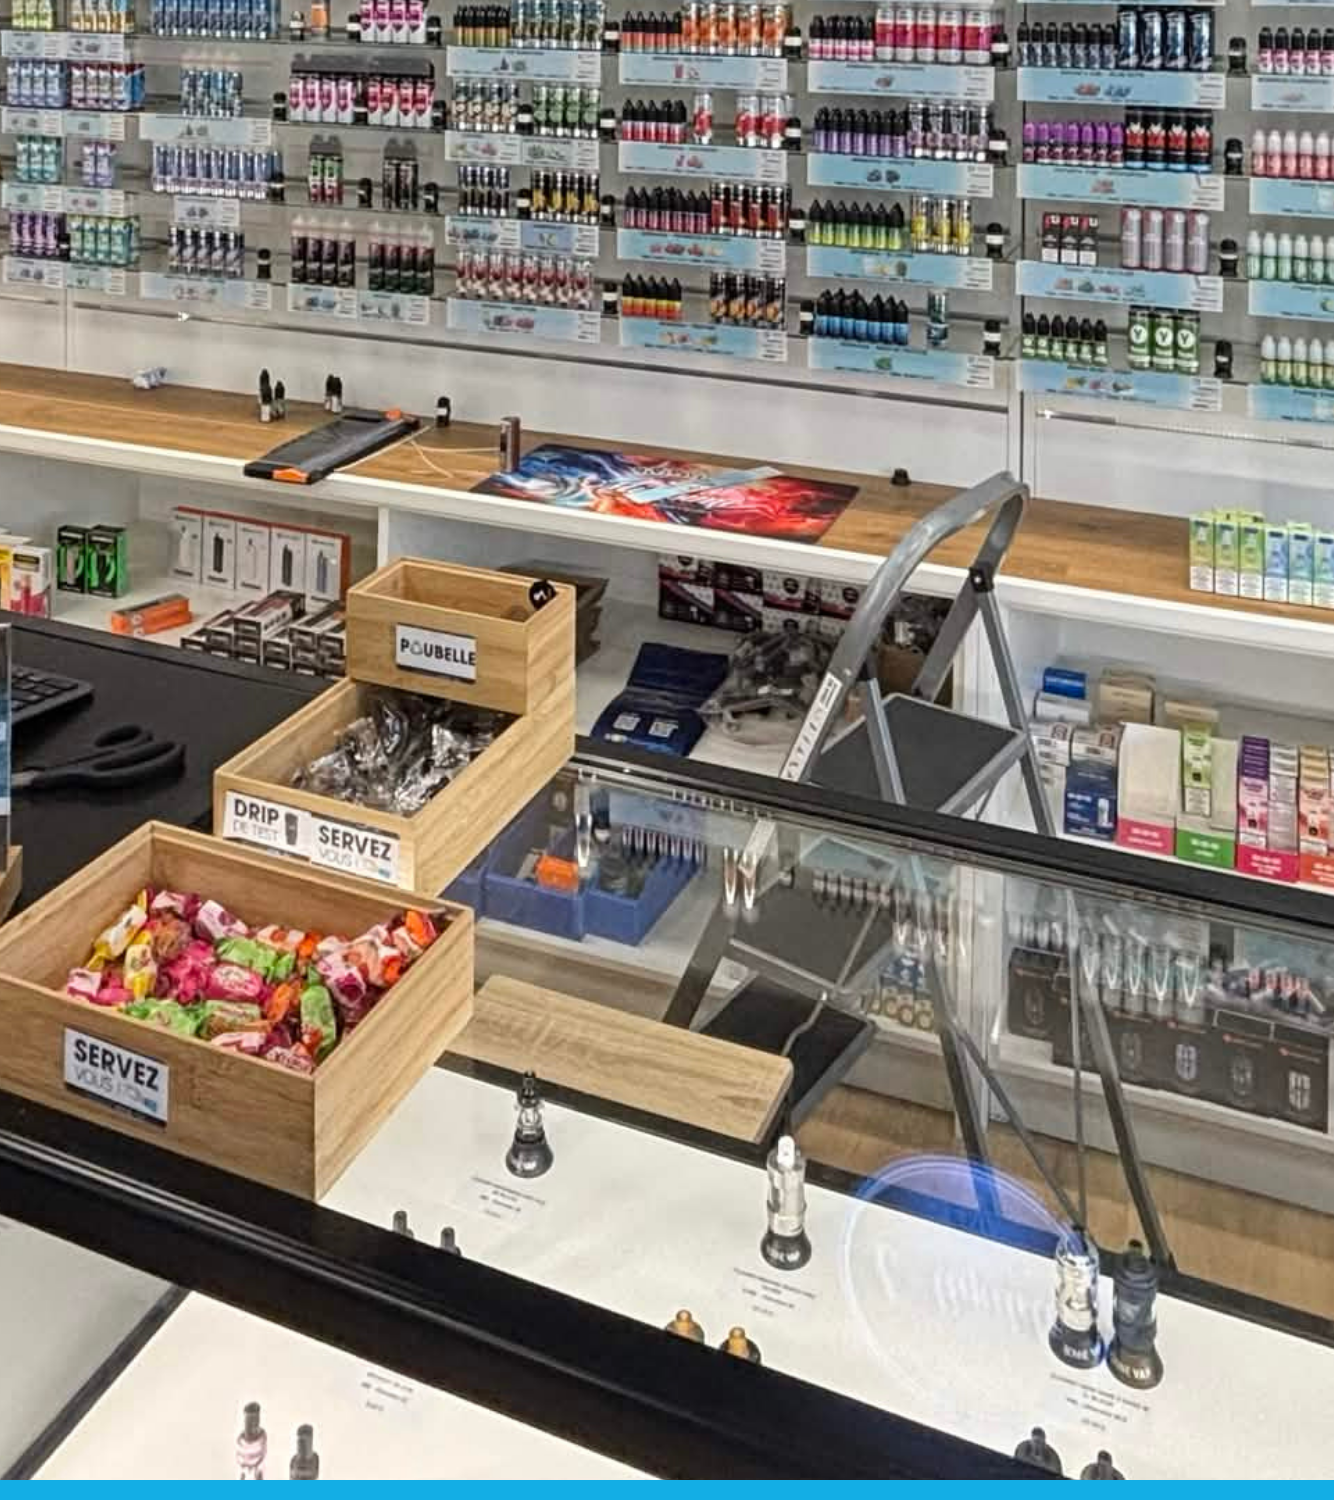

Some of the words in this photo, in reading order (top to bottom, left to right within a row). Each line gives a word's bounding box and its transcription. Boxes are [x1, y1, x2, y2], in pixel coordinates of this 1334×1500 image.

[234, 798, 280, 825] DRIP
[319, 825, 392, 861] SERVEZ
[74, 1038, 159, 1092] SERVEZ
